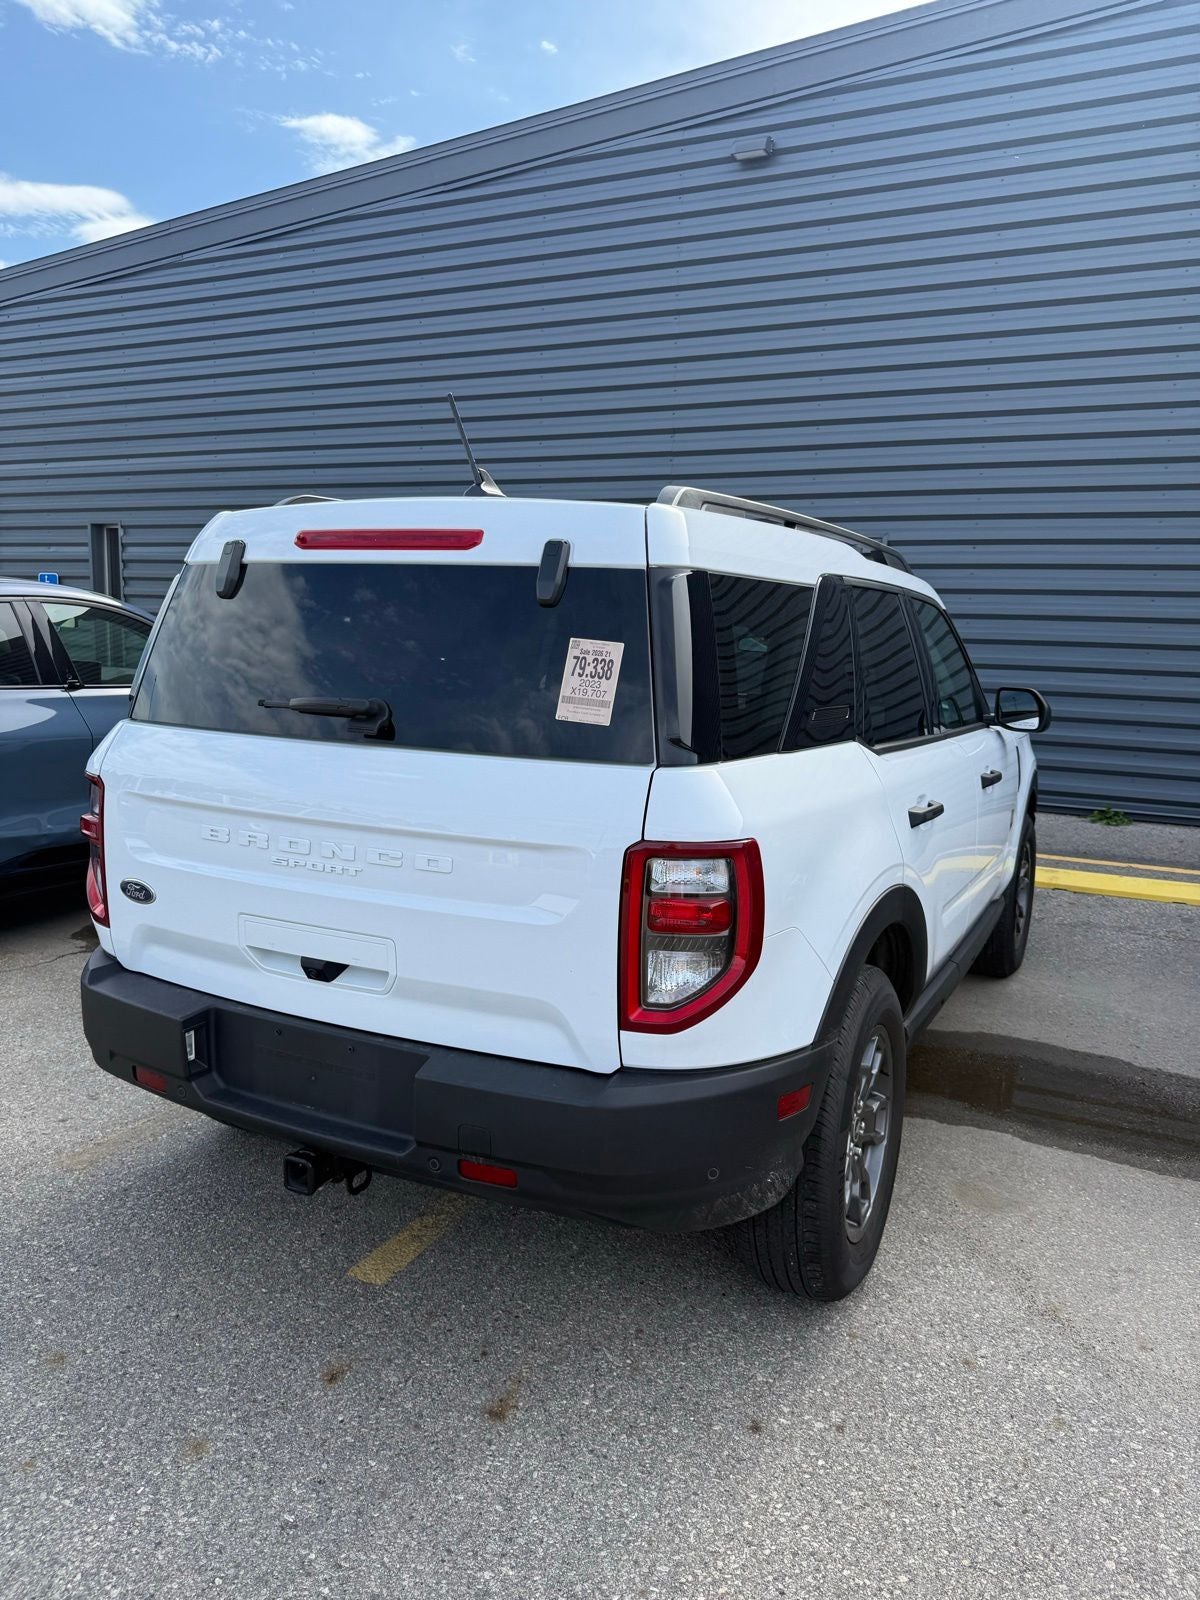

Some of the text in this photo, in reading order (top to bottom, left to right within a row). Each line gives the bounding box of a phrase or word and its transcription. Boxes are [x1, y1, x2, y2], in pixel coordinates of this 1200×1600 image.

[580, 648, 590, 656] Sale
[570, 655, 614, 680] 79:338
[579, 679, 601, 688] 2023
[201, 824, 454, 875] BRONCO
[270, 855, 363, 877] SPORT
[125, 882, 146, 900] Ford
